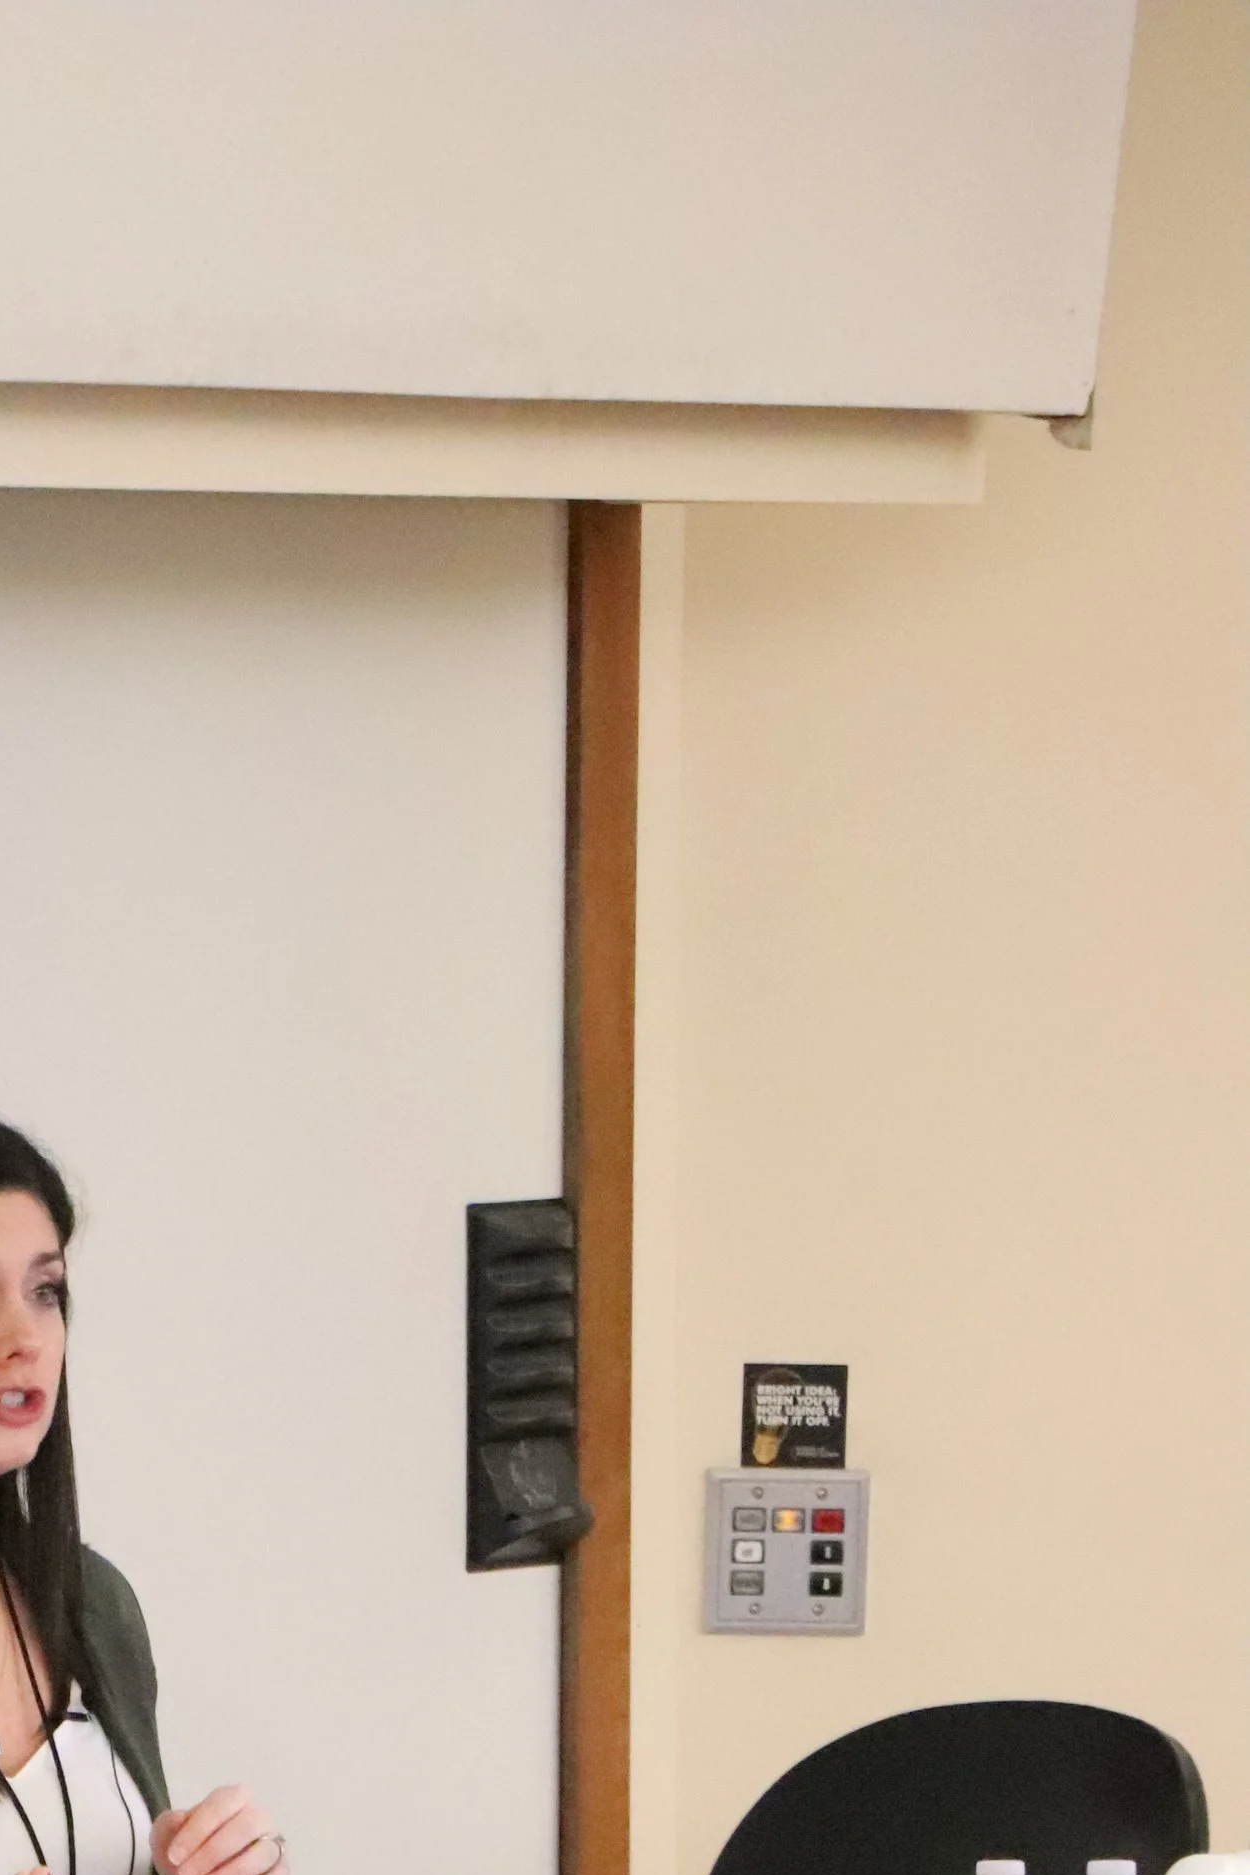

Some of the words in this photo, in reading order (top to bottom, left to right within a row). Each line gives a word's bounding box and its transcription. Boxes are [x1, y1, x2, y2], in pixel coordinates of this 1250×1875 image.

[756, 1384, 802, 1396] BRIGHT
[756, 1395, 794, 1406] WHEN
[756, 1406, 783, 1416] NOT
[785, 1406, 826, 1417] USING
[756, 1416, 789, 1426] TURN
[791, 1416, 804, 1427] IT
